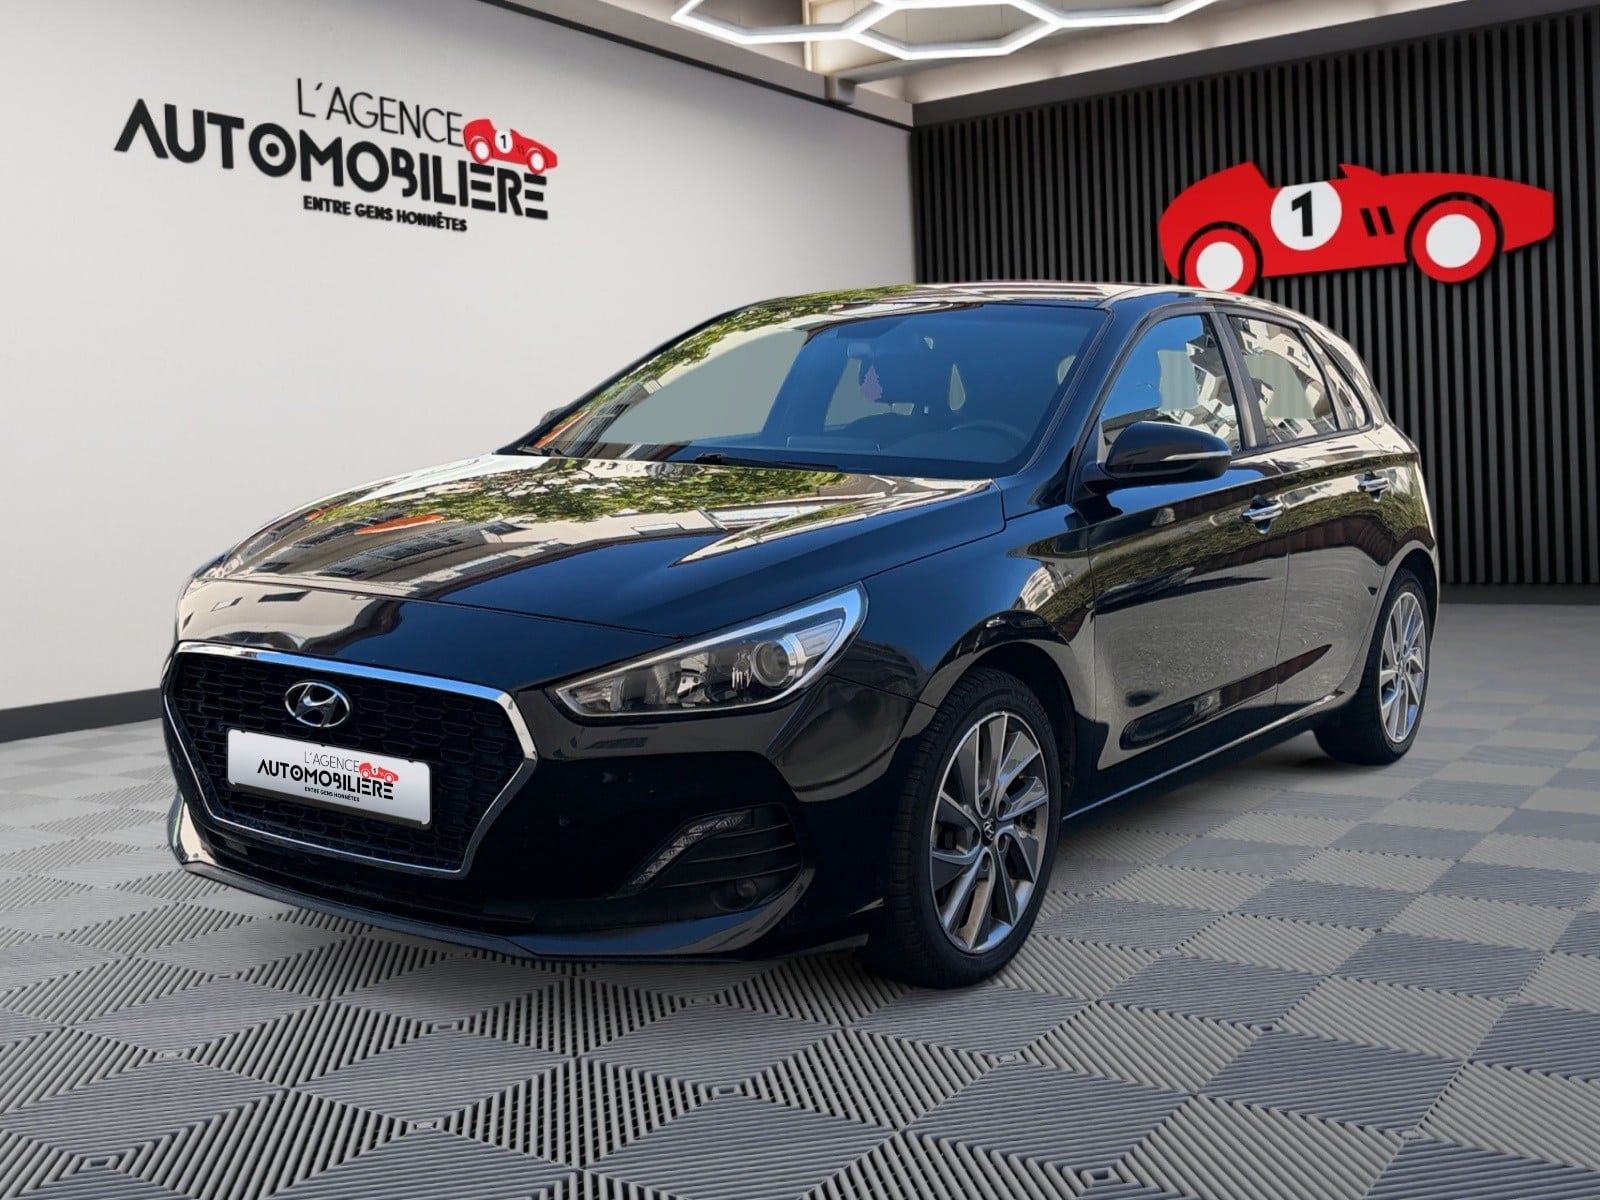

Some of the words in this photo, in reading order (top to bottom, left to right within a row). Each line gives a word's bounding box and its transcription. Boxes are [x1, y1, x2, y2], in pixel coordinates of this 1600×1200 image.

[297, 78, 464, 147] L'AGENCE
[500, 133, 508, 149] 1
[303, 195, 352, 216] ENTRE
[354, 203, 394, 221] GENS
[396, 209, 468, 232] HONNÊTES
[1291, 190, 1313, 237] 1
[304, 751, 360, 773] L'AGENCE
[304, 786, 320, 794] ENTRE
